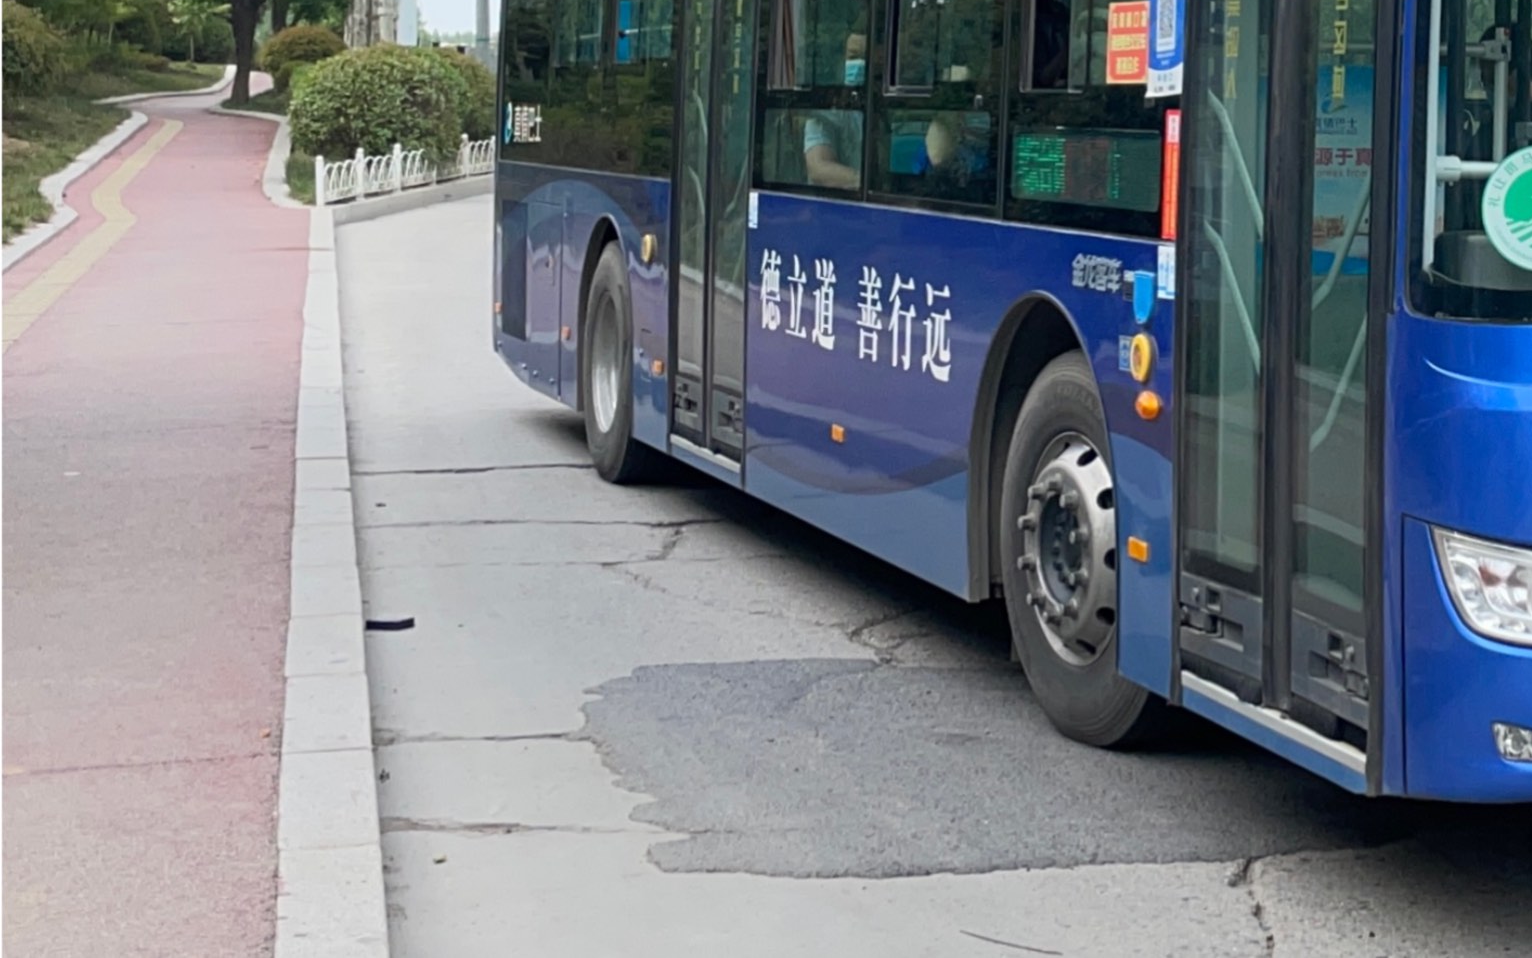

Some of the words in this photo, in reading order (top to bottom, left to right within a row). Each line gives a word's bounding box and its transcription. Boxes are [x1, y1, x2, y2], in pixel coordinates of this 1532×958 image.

[760, 248, 836, 350] 德立道
[857, 266, 951, 382] 善行远
